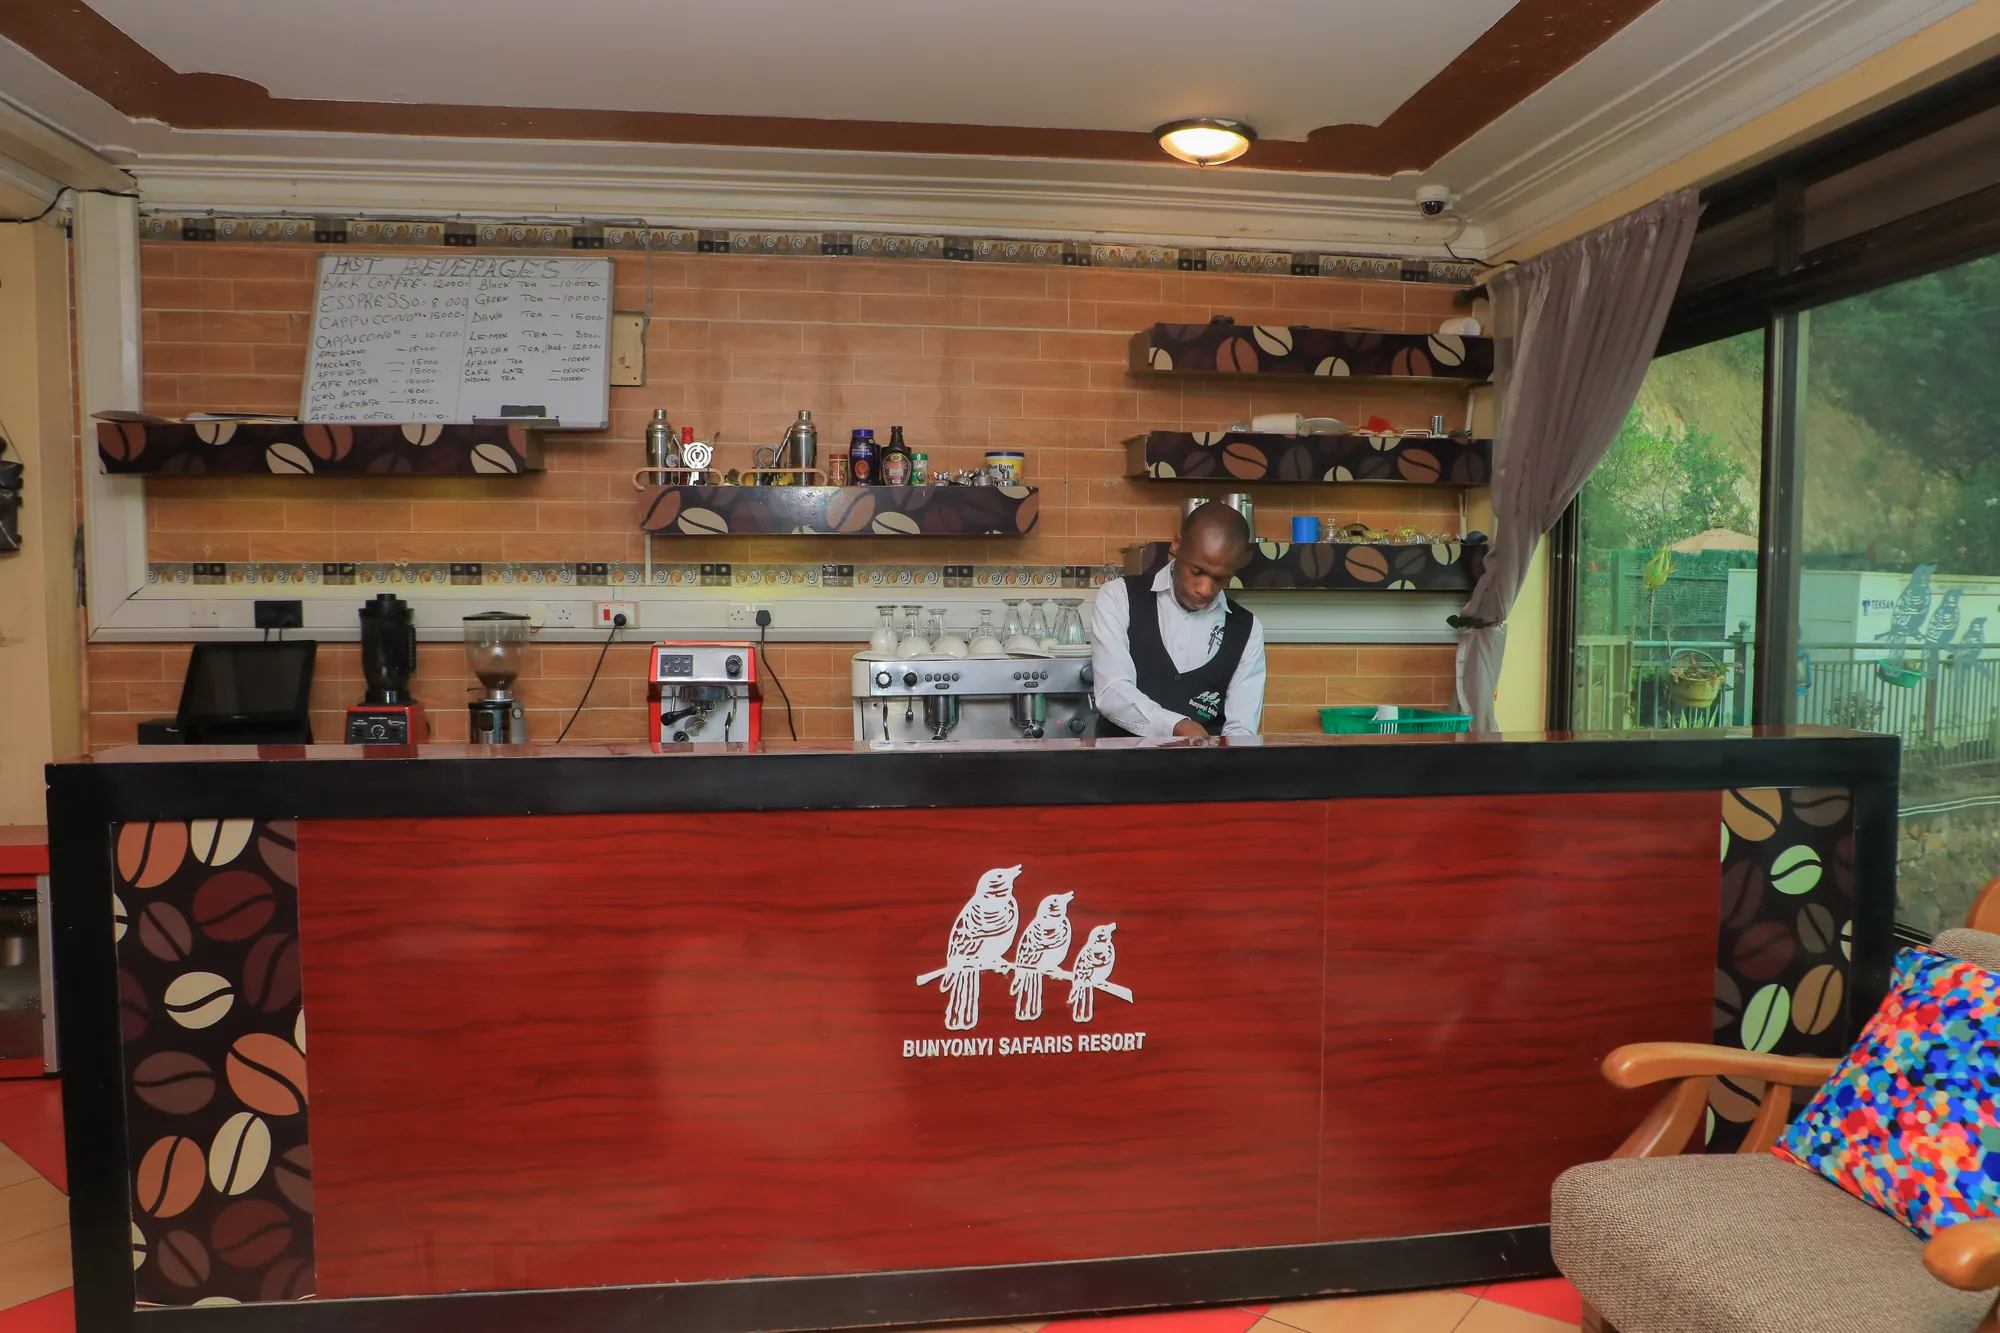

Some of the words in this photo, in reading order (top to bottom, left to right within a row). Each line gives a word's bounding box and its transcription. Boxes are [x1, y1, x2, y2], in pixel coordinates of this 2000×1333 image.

[332, 256, 383, 275] HOT
[401, 257, 561, 279] BEVERAGES
[516, 281, 537, 289] TEA
[520, 293, 544, 303] TEA
[520, 310, 543, 318] TEA
[521, 330, 548, 339] TEA
[516, 344, 540, 353] TEA
[1871, 599, 1895, 610] TEKSAN
[902, 1038, 994, 1058] BUNYONYI
[998, 1035, 1073, 1055] SAFARIS
[1077, 1032, 1147, 1052] RESORT
